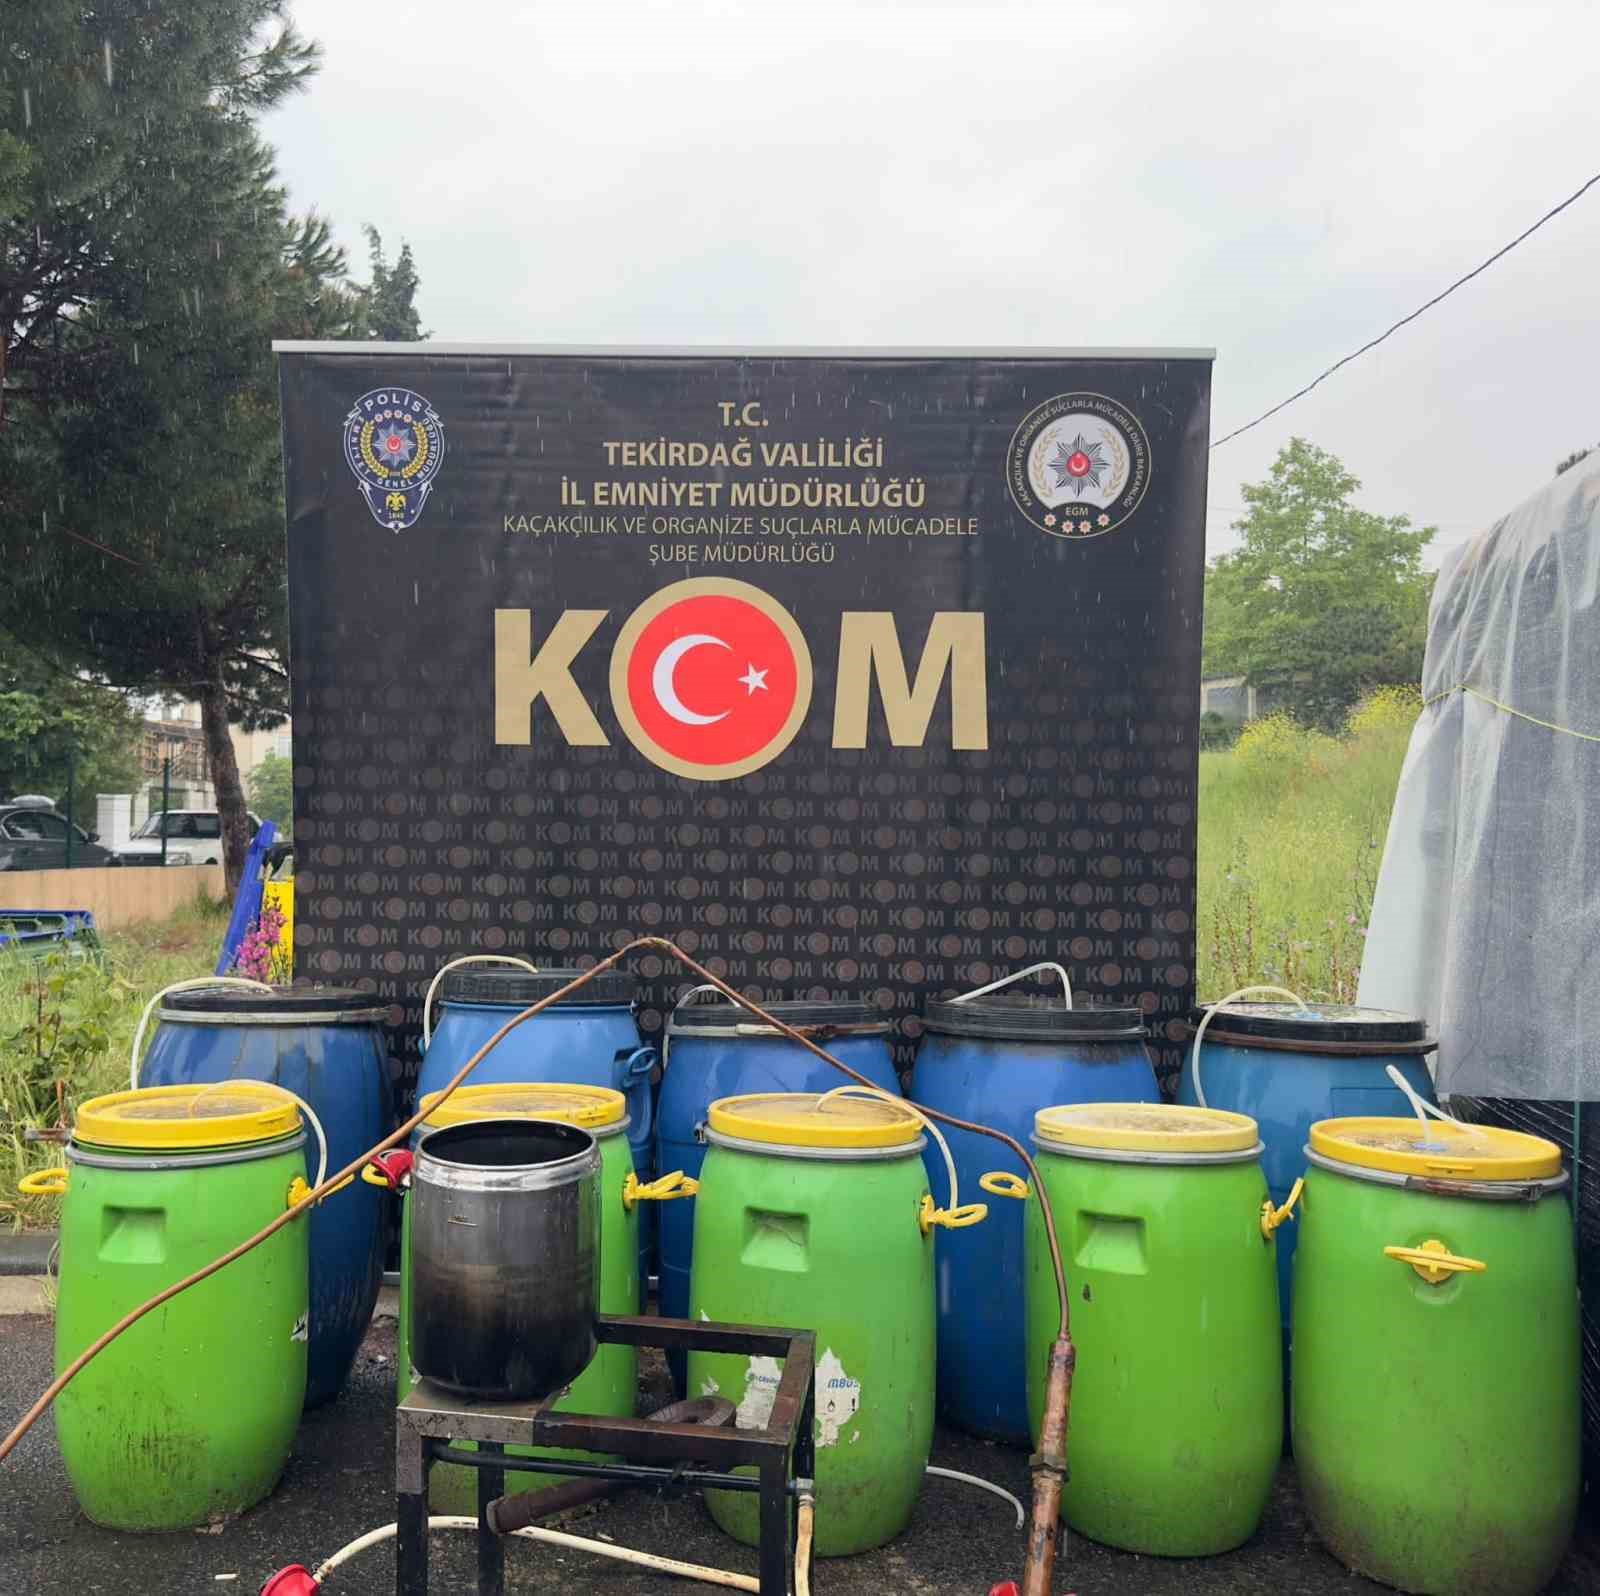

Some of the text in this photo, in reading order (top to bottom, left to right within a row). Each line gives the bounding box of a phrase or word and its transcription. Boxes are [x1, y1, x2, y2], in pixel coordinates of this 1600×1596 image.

[364, 393, 422, 412] POLİS
[718, 402, 769, 426] T.C.
[603, 437, 883, 467] TEKİRDAĞ VALİLİĞİ
[560, 476, 926, 508] İL EMNİYET MÜDÜRLÜĞÜ
[1065, 507, 1089, 516] EGM
[503, 514, 979, 539] KAÇAKÇILIK VE ORGANİZE SUÇLARLA MÜCADELE
[649, 542, 835, 566] ŞUBE MÜDÜRLÜĞÜ
